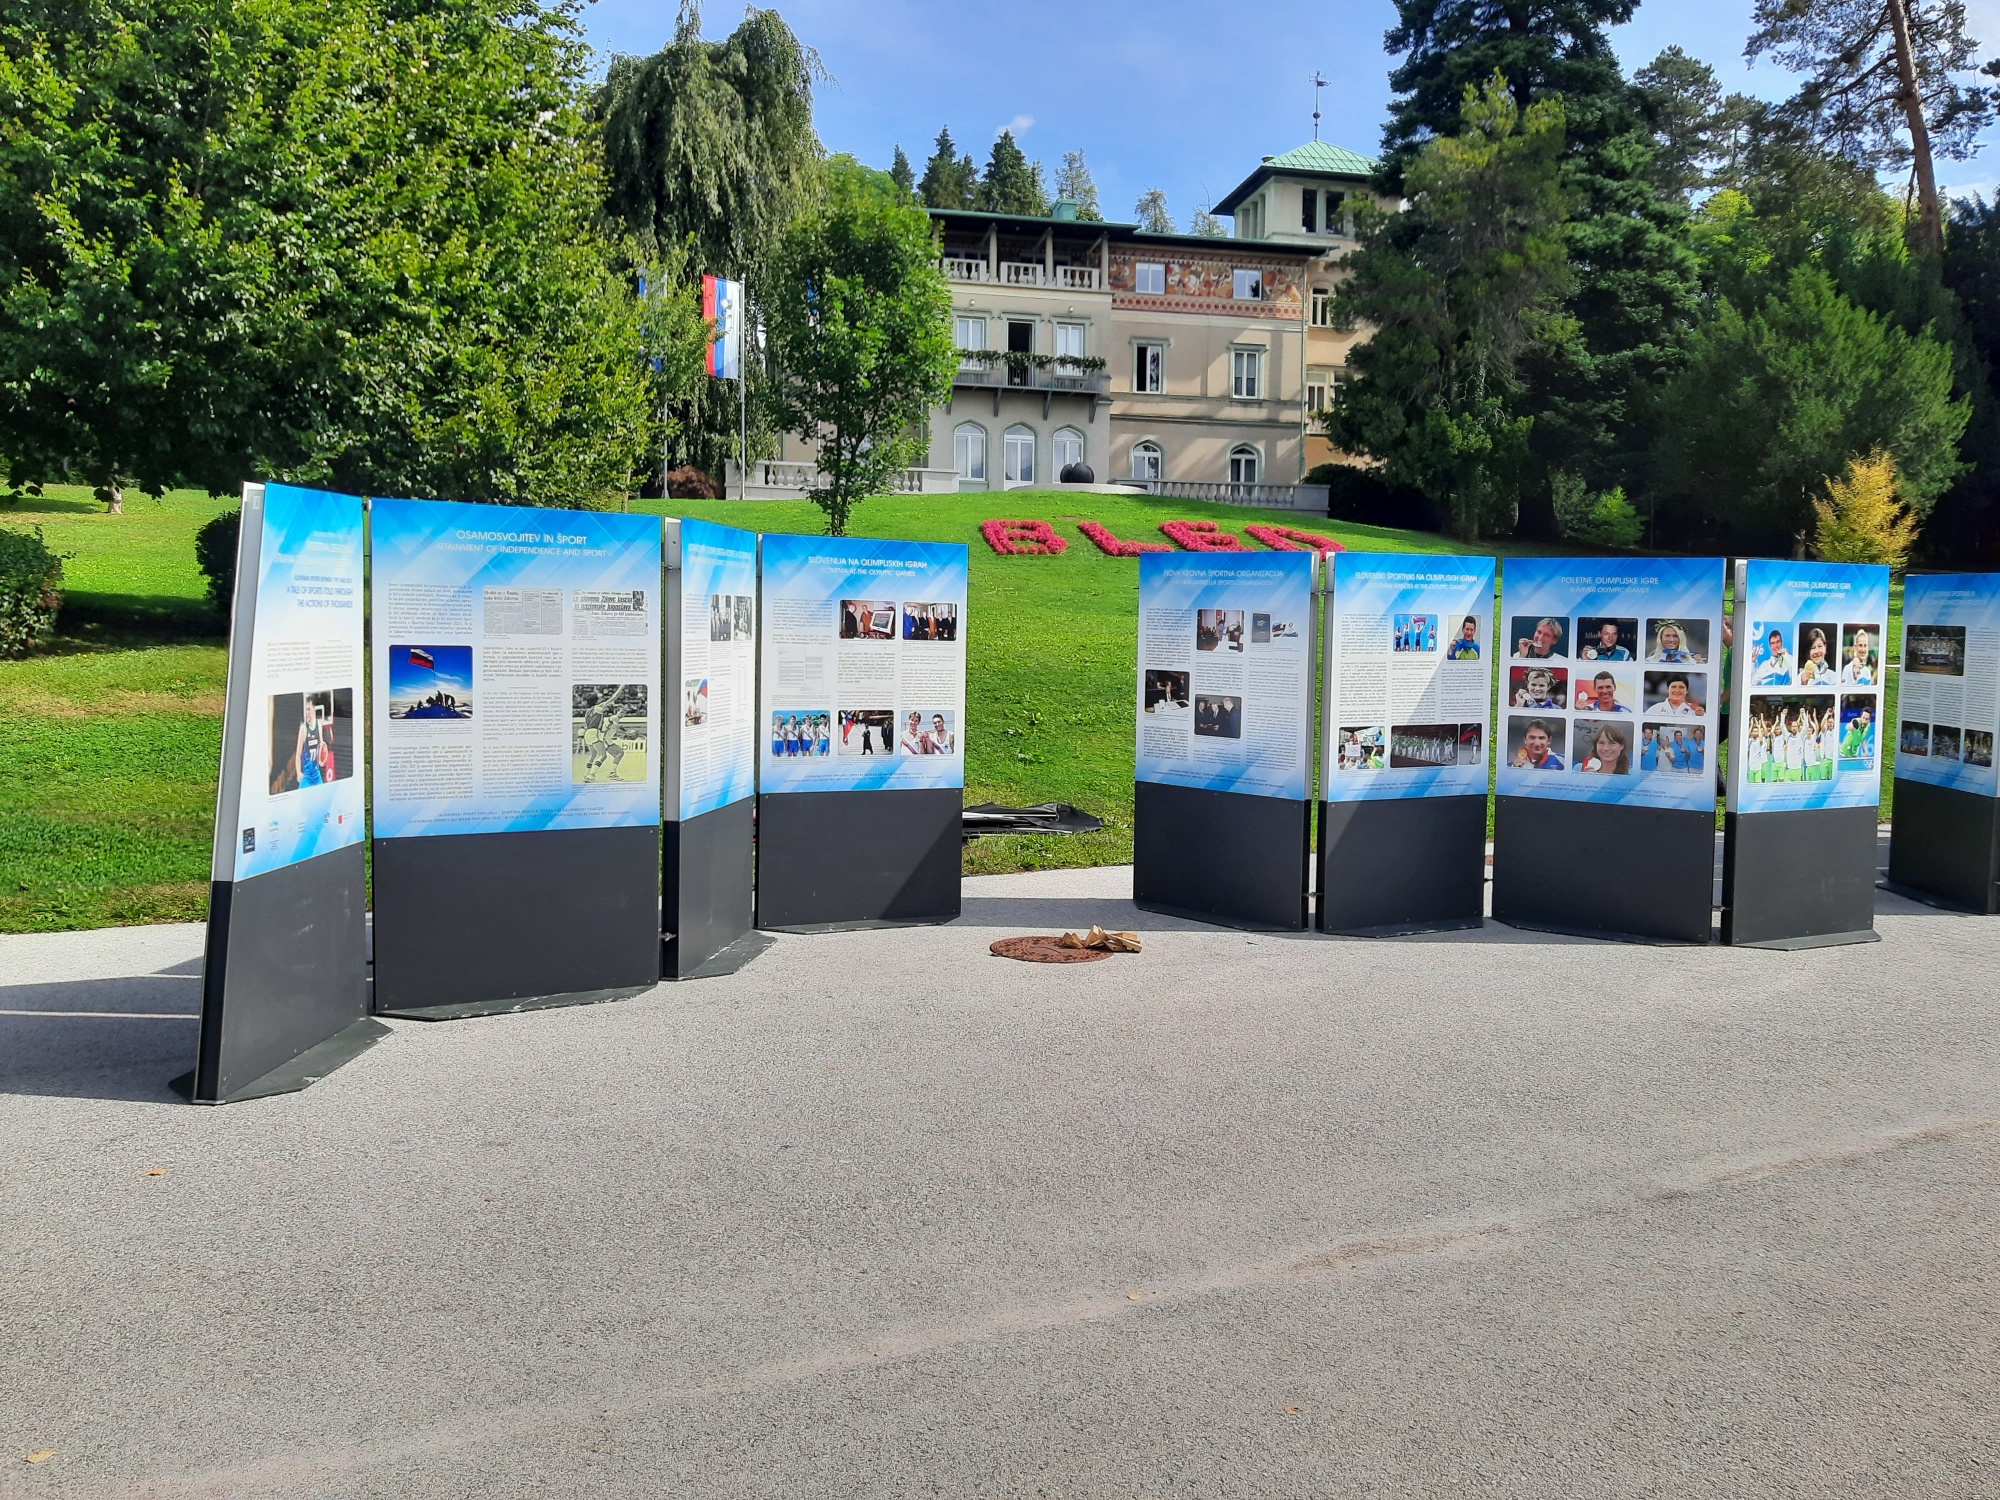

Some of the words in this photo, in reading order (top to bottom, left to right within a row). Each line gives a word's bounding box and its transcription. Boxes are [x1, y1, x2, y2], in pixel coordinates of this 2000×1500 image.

[456, 530, 541, 543] OSAMOSVOJITEV
[543, 533, 554, 543] IN
[557, 532, 587, 545] ŠPORT
[486, 544, 498, 553] OF
[500, 545, 561, 555] INDEPENDENCE
[563, 548, 581, 556] AND
[582, 549, 607, 557] SPORT
[808, 556, 846, 565] SLOVENIJA
[861, 558, 903, 567] OLIMPIJSKIH
[1208, 569, 1235, 577] ŠPORTNA
[1561, 576, 1594, 584] POLETNE
[1595, 577, 1638, 585] OLIMPIJSKE
